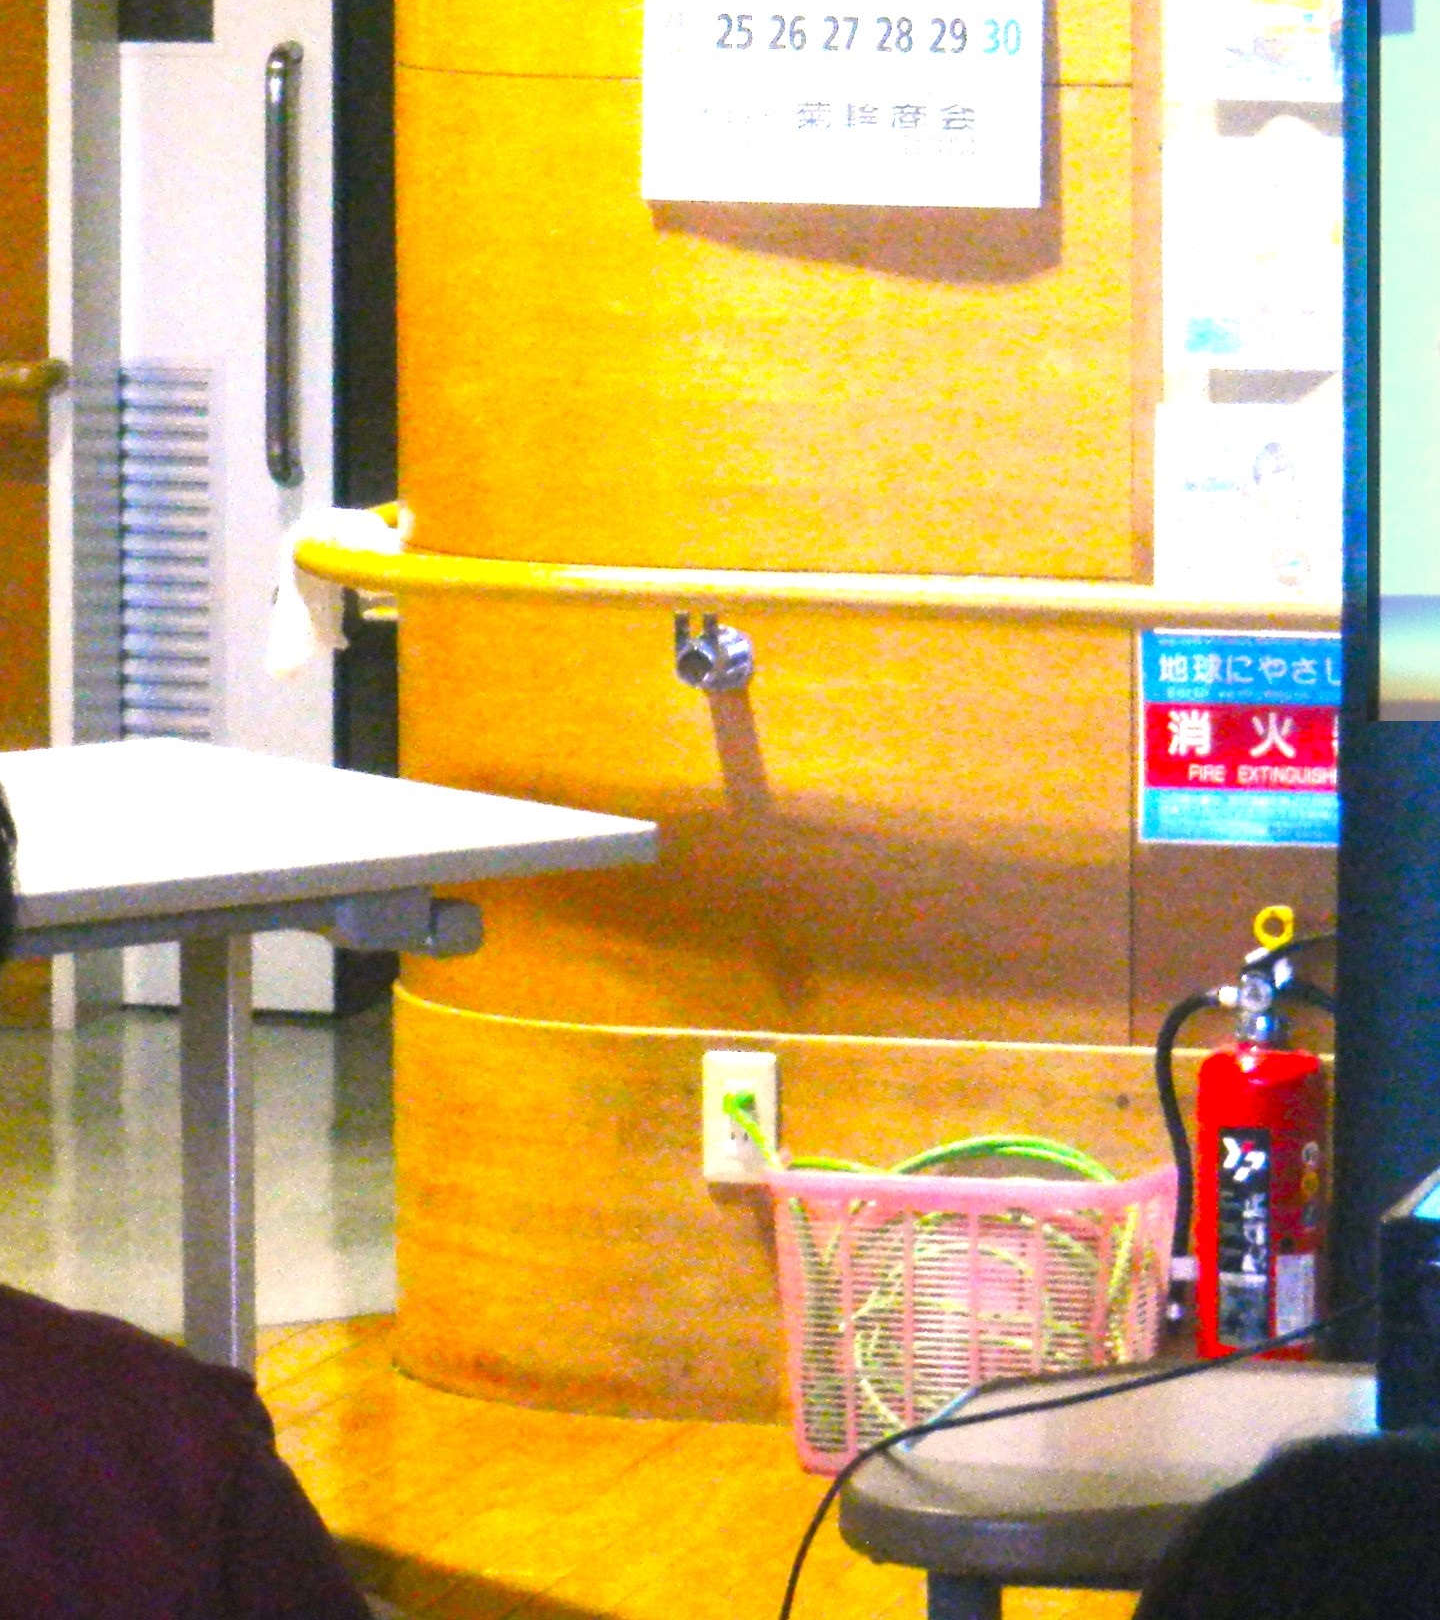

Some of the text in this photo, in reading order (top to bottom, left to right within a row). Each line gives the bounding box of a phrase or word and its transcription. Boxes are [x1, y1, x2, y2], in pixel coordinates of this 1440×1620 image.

[715, 12, 756, 52] 25
[769, 14, 809, 54] 26
[822, 15, 862, 54] 27
[875, 15, 916, 56] 28
[929, 17, 971, 57] 29
[983, 18, 1024, 58] 30
[1158, 652, 1341, 686] 地球にやさし
[1167, 709, 1339, 759] 消火
[1188, 763, 1338, 786] FIRE EXTINGUISH
